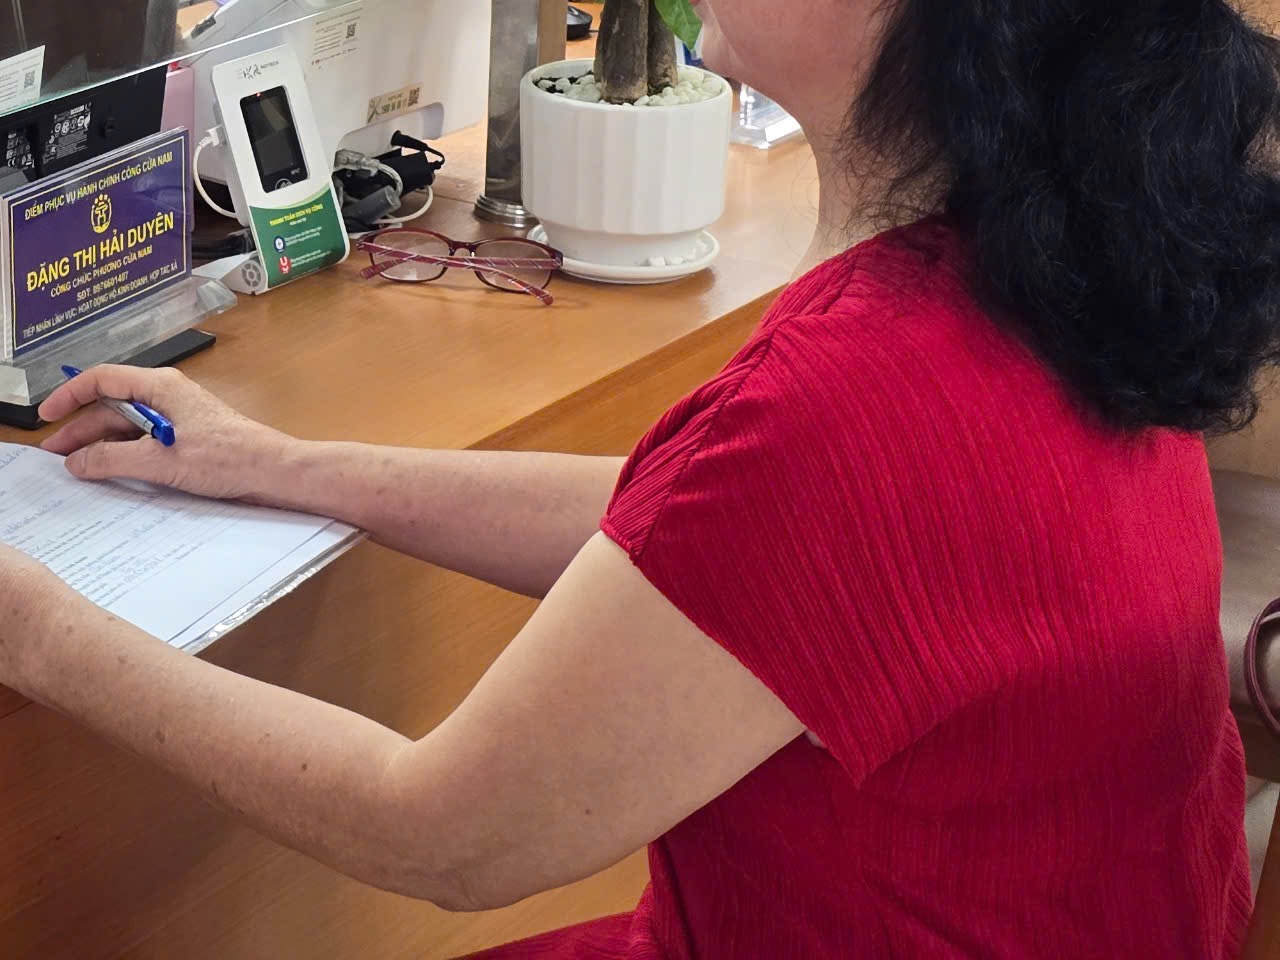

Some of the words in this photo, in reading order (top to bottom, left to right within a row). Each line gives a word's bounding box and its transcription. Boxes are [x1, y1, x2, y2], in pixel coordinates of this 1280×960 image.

[44, 194, 65, 212] PHỤC
[65, 190, 76, 205] VỤ
[121, 164, 142, 181] CÔNG
[157, 151, 173, 166] NAM
[27, 256, 70, 292] ĐẶNG
[73, 244, 96, 270] THỊ
[100, 229, 124, 260] HẢI
[127, 211, 174, 248] DUYÊN
